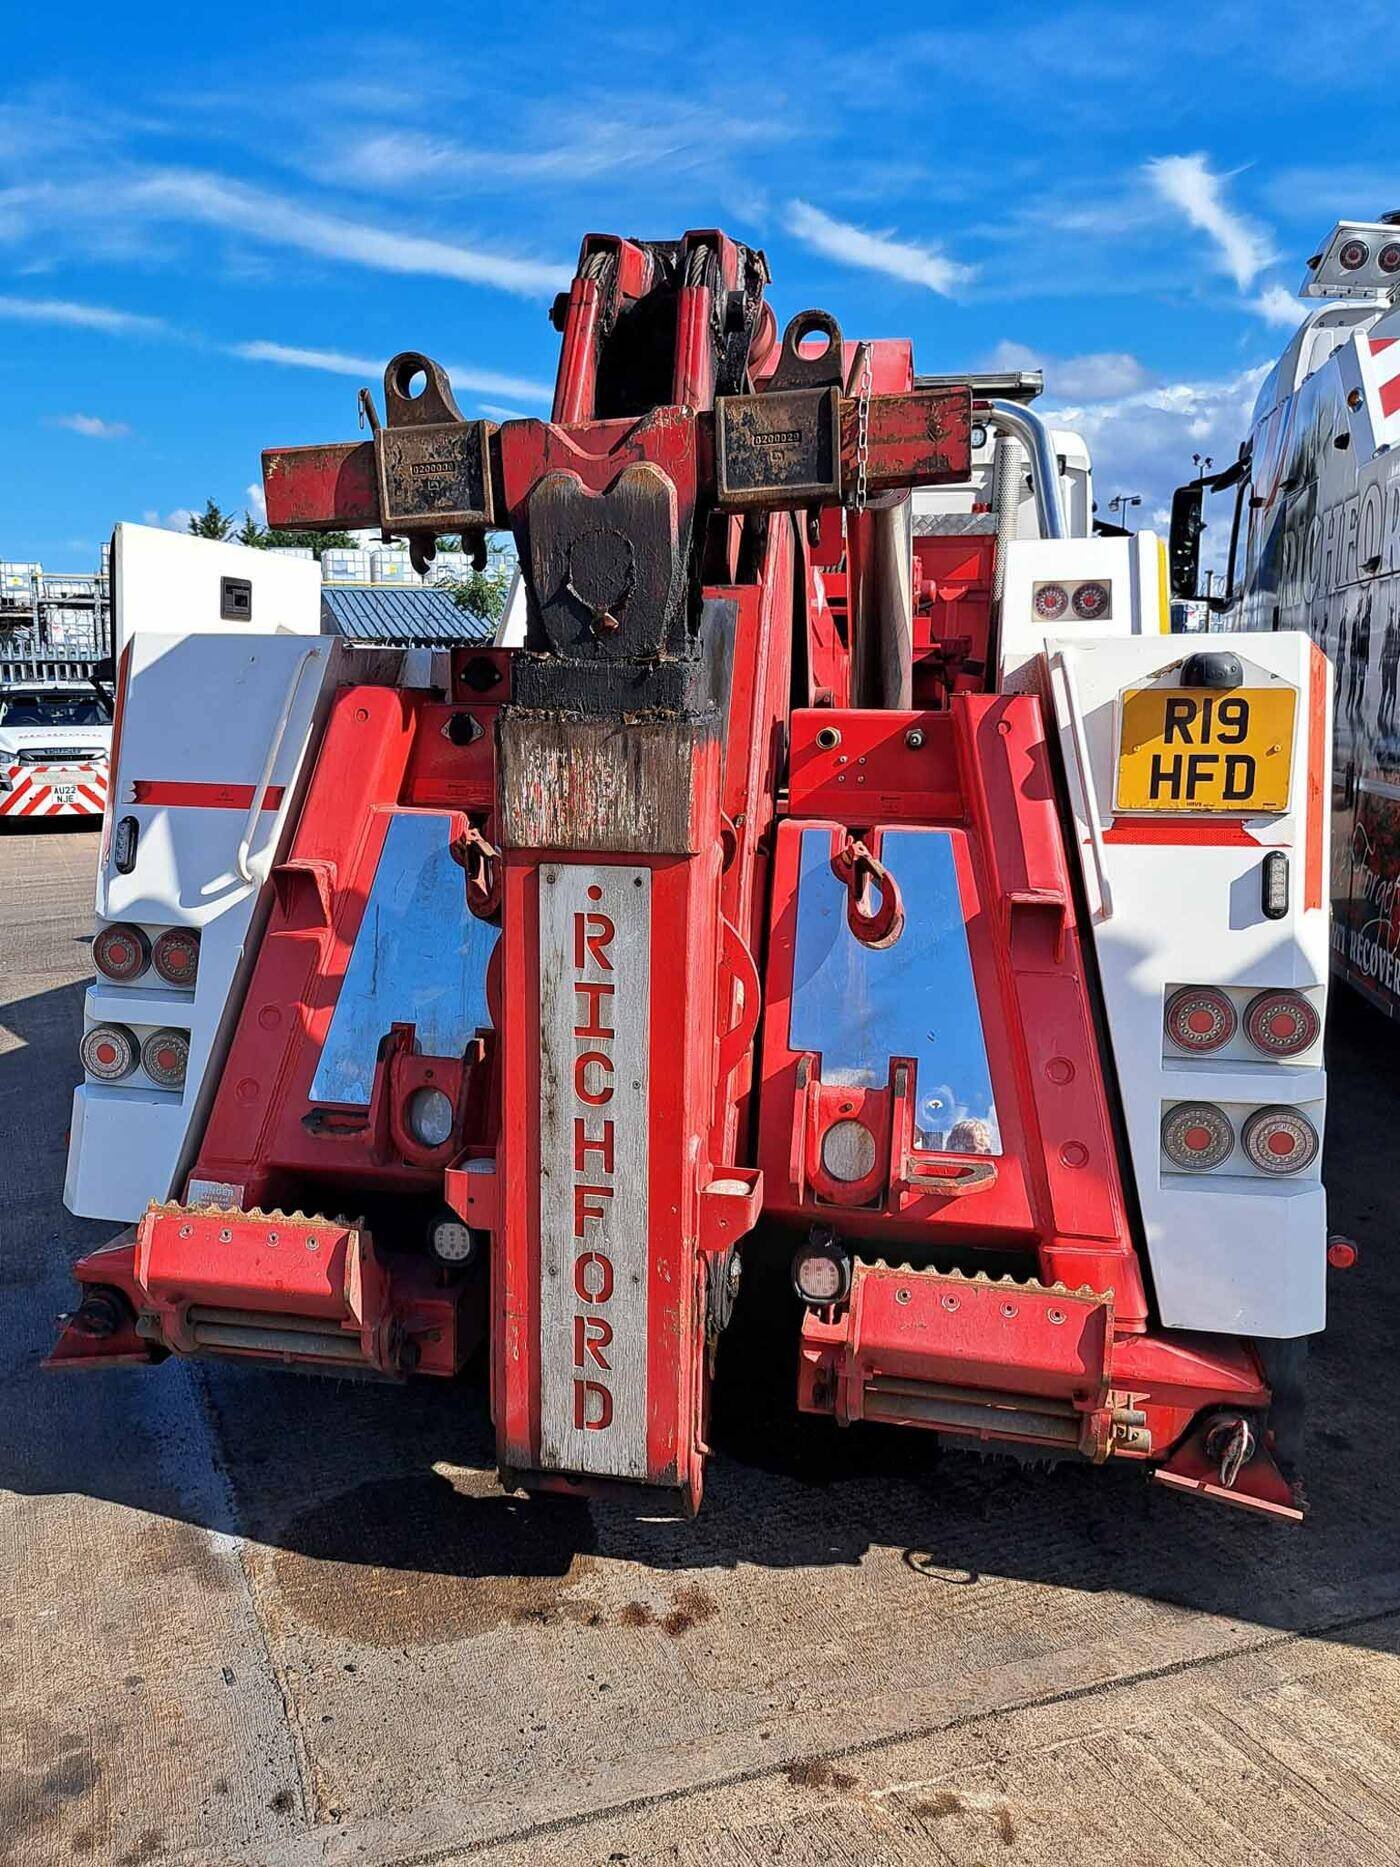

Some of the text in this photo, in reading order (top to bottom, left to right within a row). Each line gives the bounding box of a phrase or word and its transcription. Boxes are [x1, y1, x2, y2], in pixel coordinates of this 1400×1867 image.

[1164, 698, 1249, 744] R19
[54, 786, 76, 794] AU22
[1150, 754, 1256, 800] HFD
[574, 912, 615, 1431] RICHFORD
